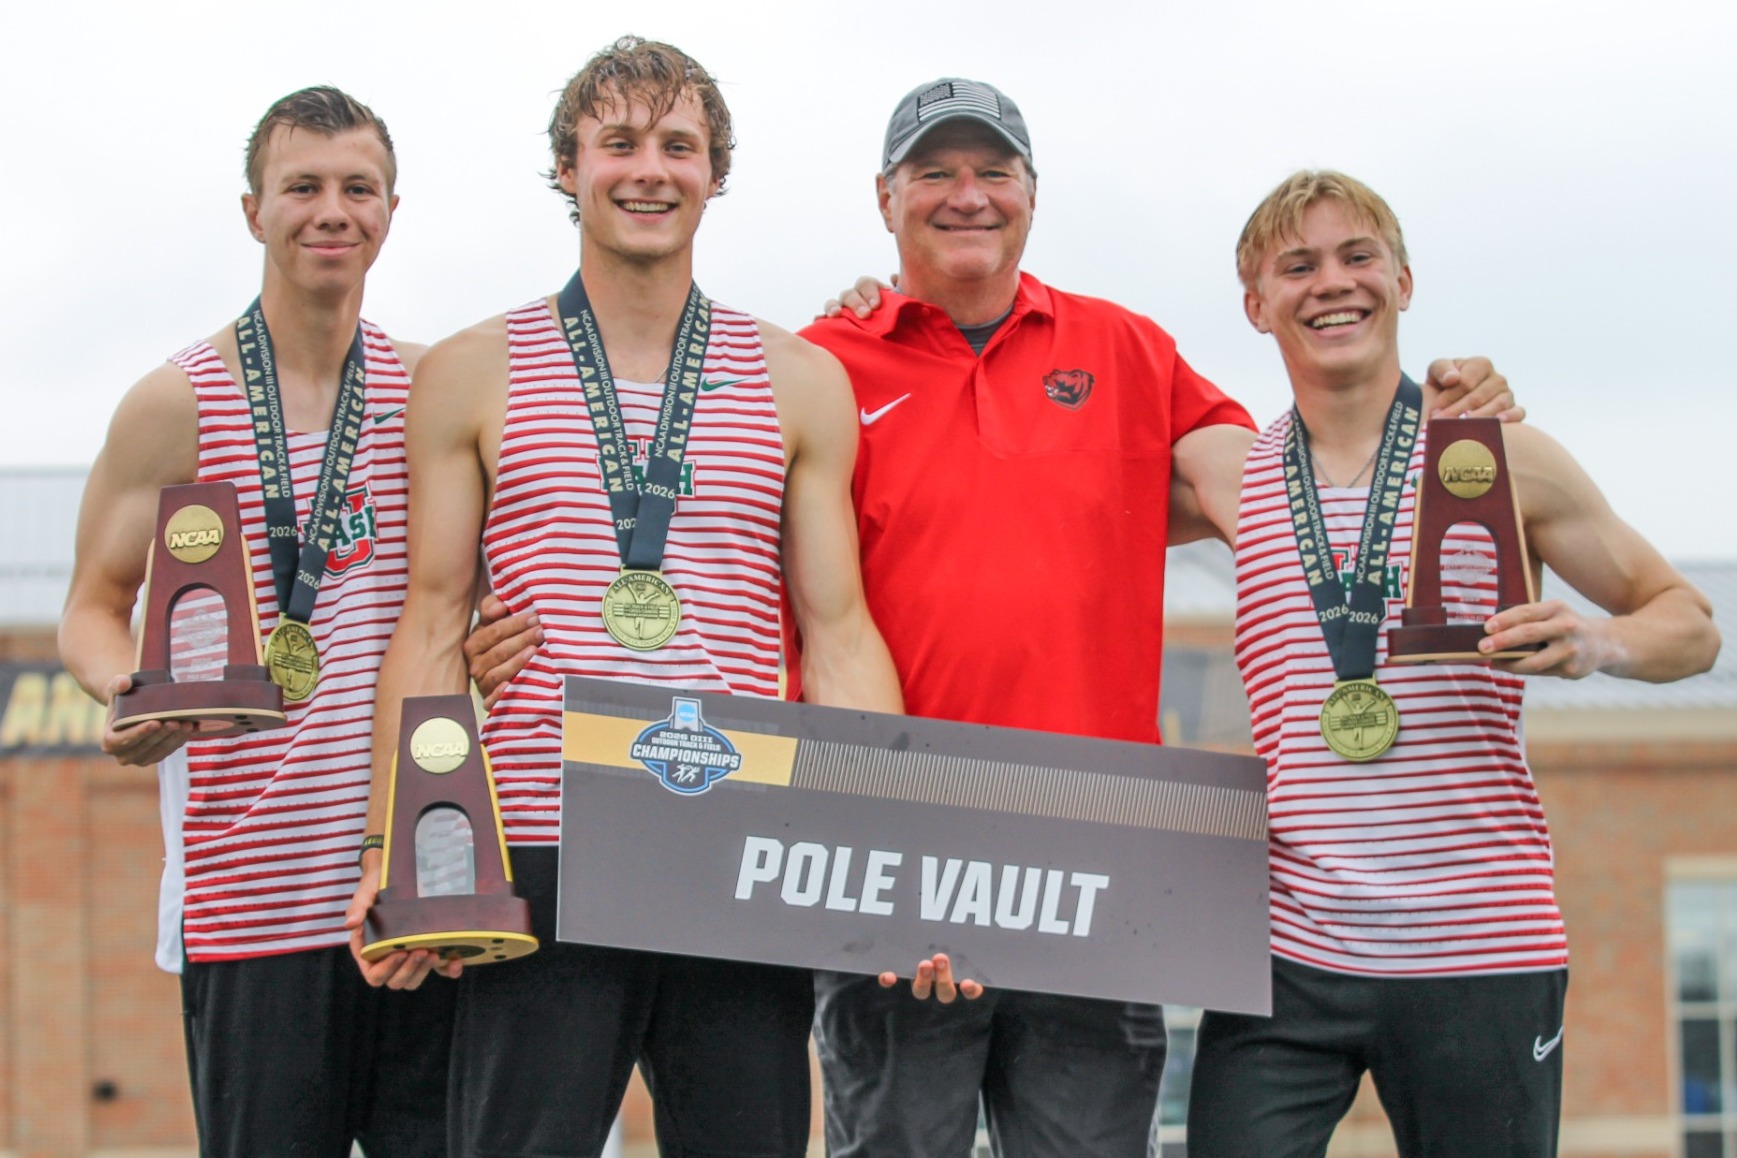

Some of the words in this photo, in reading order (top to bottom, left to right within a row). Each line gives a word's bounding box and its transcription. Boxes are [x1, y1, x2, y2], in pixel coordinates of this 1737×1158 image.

[253, 309, 264, 335] NCAA
[580, 309, 594, 334] NCAA
[680, 311, 693, 336] TRACK
[258, 334, 272, 374] DIVISION
[588, 333, 606, 375] DIVISION
[670, 337, 687, 381] OUTDOOR
[265, 375, 274, 384] III
[599, 370, 609, 380] III
[669, 382, 678, 391] III
[237, 316, 280, 499] ALL-AMERICAN
[266, 385, 281, 433] OUTDOOR
[337, 390, 350, 419] TRACK
[563, 316, 624, 492] ALL-AMERICAN
[602, 380, 620, 428] OUTDOOR
[660, 391, 675, 430] DIVISION
[1391, 401, 1403, 423] FIELD
[274, 435, 286, 464] TRACK
[326, 418, 344, 466] OUTDOOR
[614, 428, 627, 458] TRACK
[655, 432, 667, 457] NCAA
[1381, 430, 1395, 457] TRACK
[278, 464, 287, 472] &
[317, 366, 364, 553] ALL-AMERICAN
[324, 466, 333, 476] III
[620, 458, 629, 466] &
[280, 472, 290, 498] FIELD
[622, 466, 634, 491] FIELD
[1371, 457, 1388, 503] OUTDOOR
[1443, 466, 1494, 484] NCAA
[315, 477, 330, 517] DIVISION
[645, 482, 675, 499] 2026
[1367, 406, 1419, 586] ALL-AMERICAN
[1369, 504, 1378, 513] III
[269, 526, 298, 538] 2026
[308, 518, 320, 545] NCAA
[616, 518, 637, 530] 202
[1303, 475, 1318, 521] OUTDOOR
[1313, 520, 1325, 549] TRACK
[1321, 554, 1334, 580] FIELD
[1360, 513, 1375, 555] DIVISION
[170, 529, 221, 549] NCAA
[297, 569, 320, 590] 2026
[1356, 555, 1366, 583] NCAA
[1319, 603, 1349, 622] 2026
[1348, 611, 1379, 624] 2026
[651, 737, 678, 746] OUTDOOR
[679, 740, 698, 749] TRACK
[703, 743, 721, 751] FIELD
[660, 731, 688, 741] 2026
[415, 742, 468, 760] NCAA
[632, 744, 740, 768] CHAMPIONSHIPS
[734, 835, 903, 916] POLE
[919, 855, 1110, 937] VAULT
